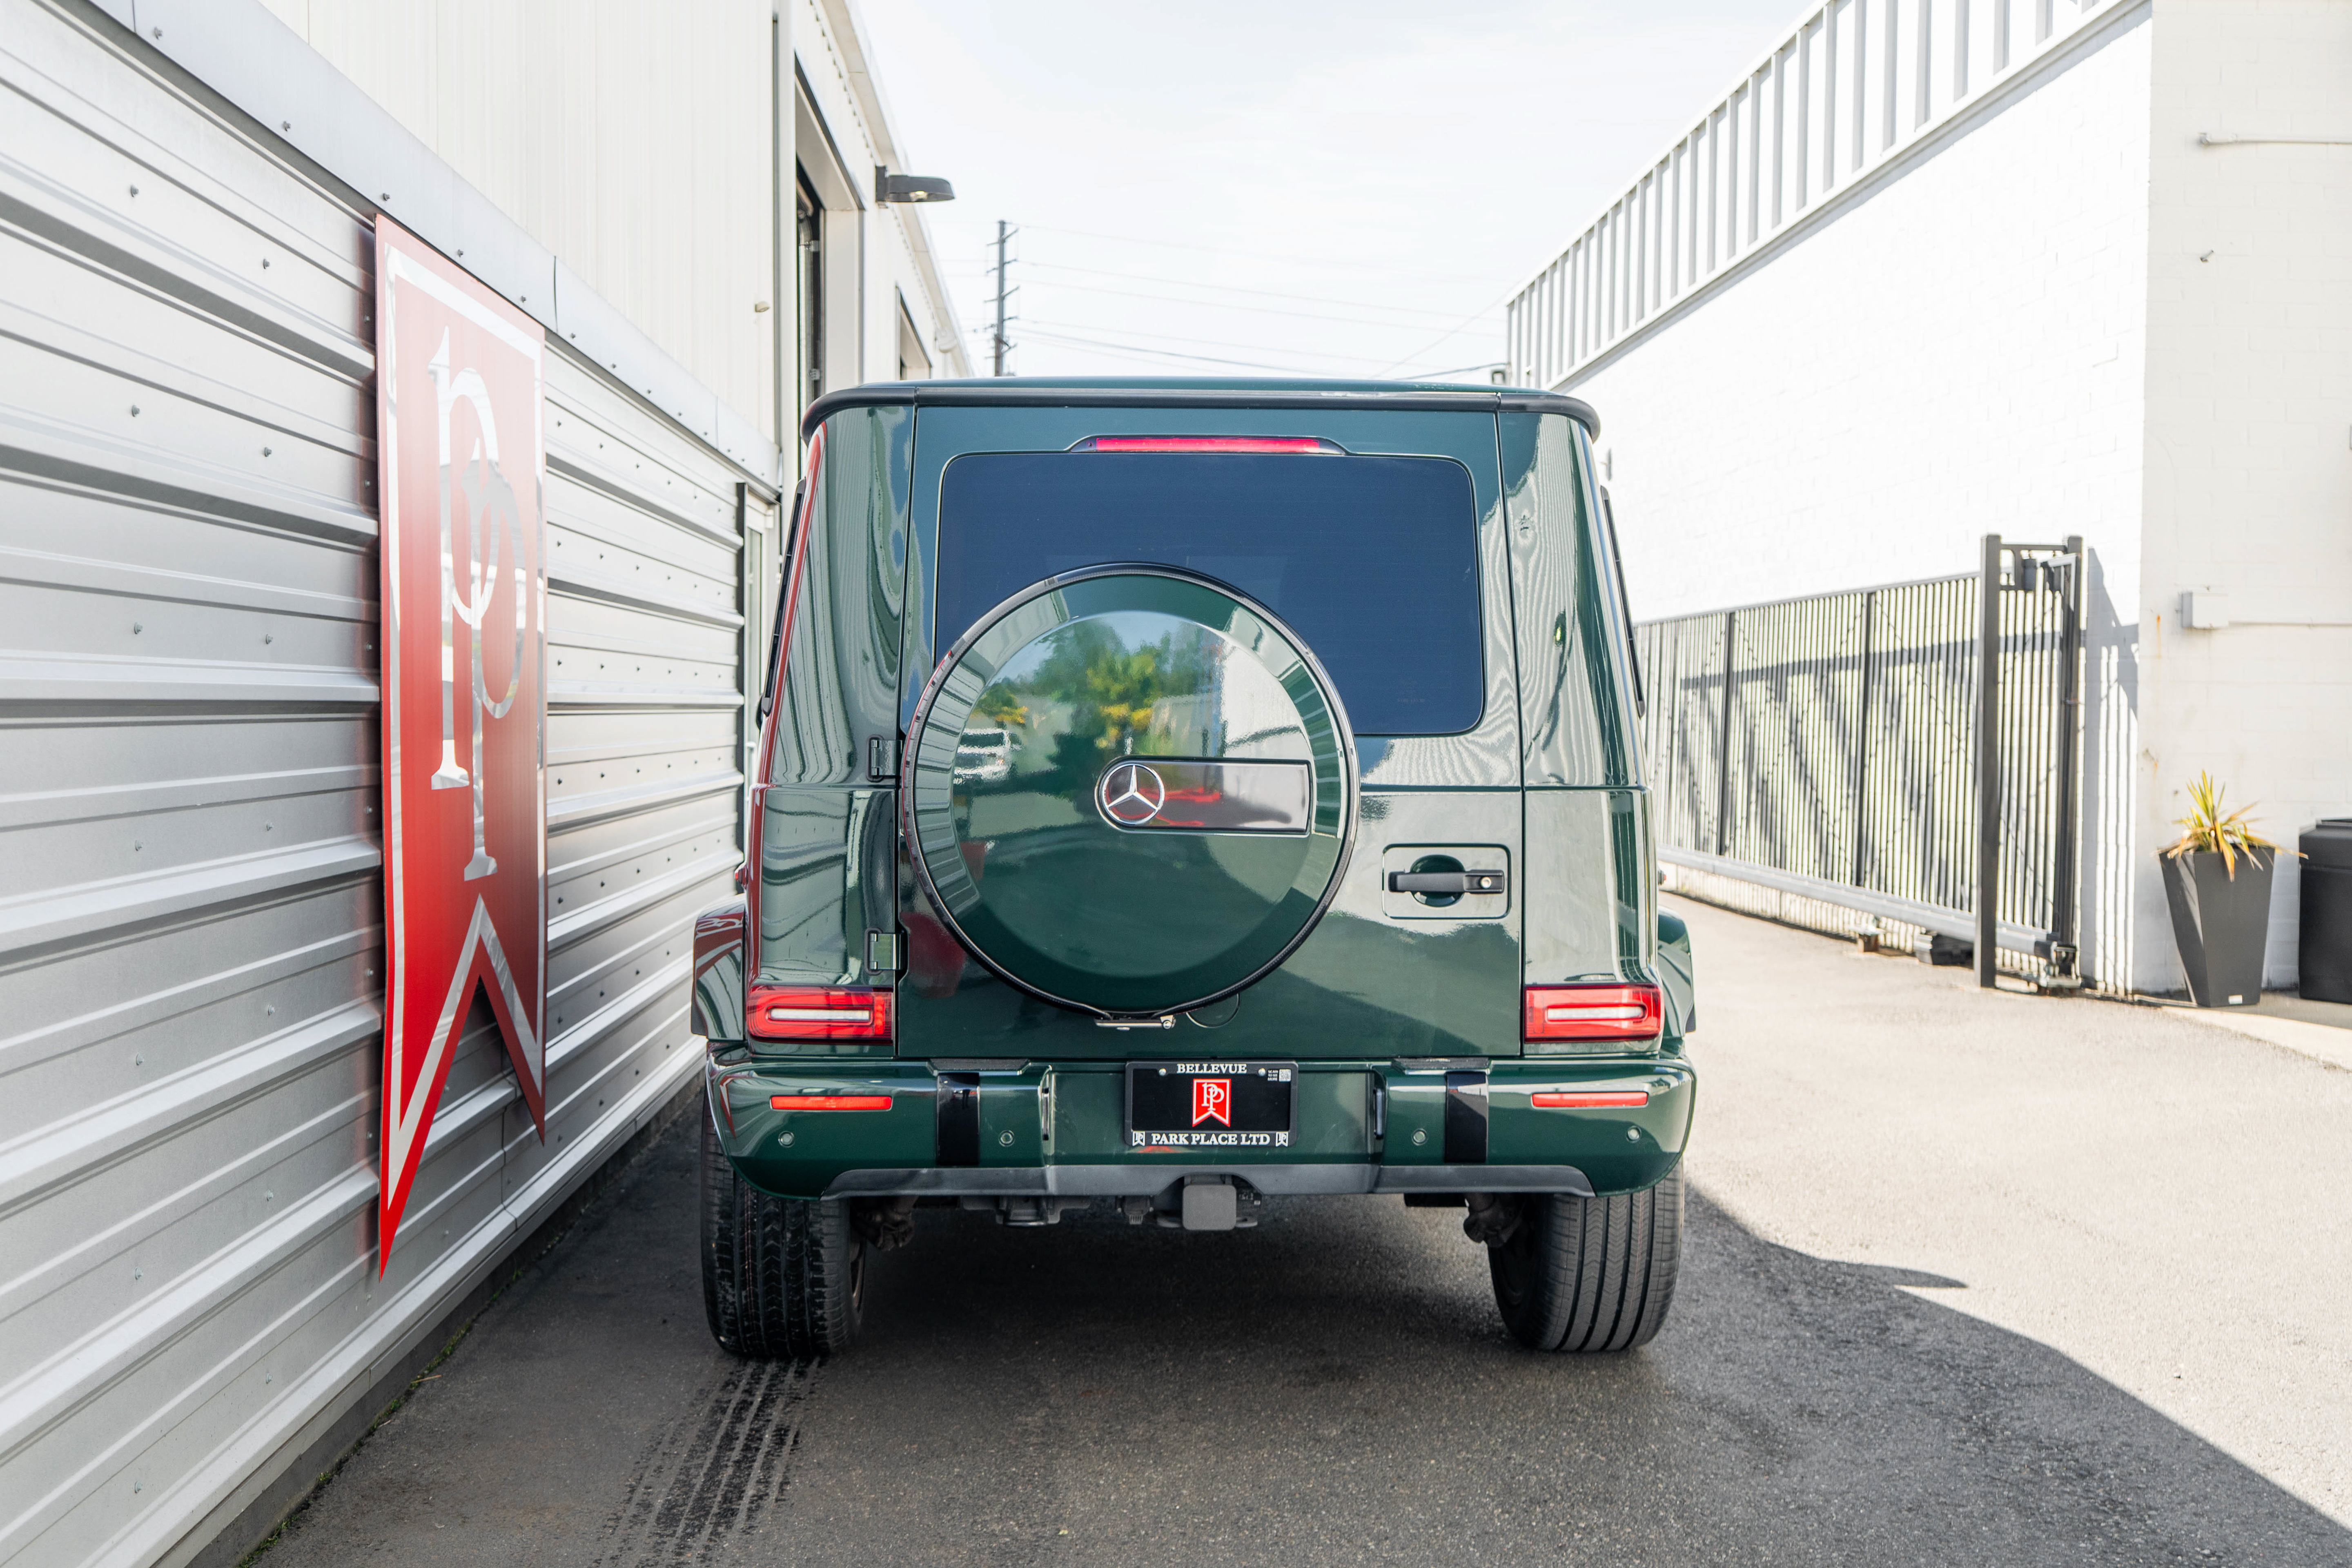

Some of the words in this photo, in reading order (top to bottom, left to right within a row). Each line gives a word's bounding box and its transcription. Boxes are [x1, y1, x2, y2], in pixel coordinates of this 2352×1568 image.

[1176, 1063, 1247, 1074] BELLEVUE
[1151, 1133, 1189, 1145] PARK
[1191, 1133, 1238, 1145] PLACE
[1240, 1134, 1270, 1145] LTD
